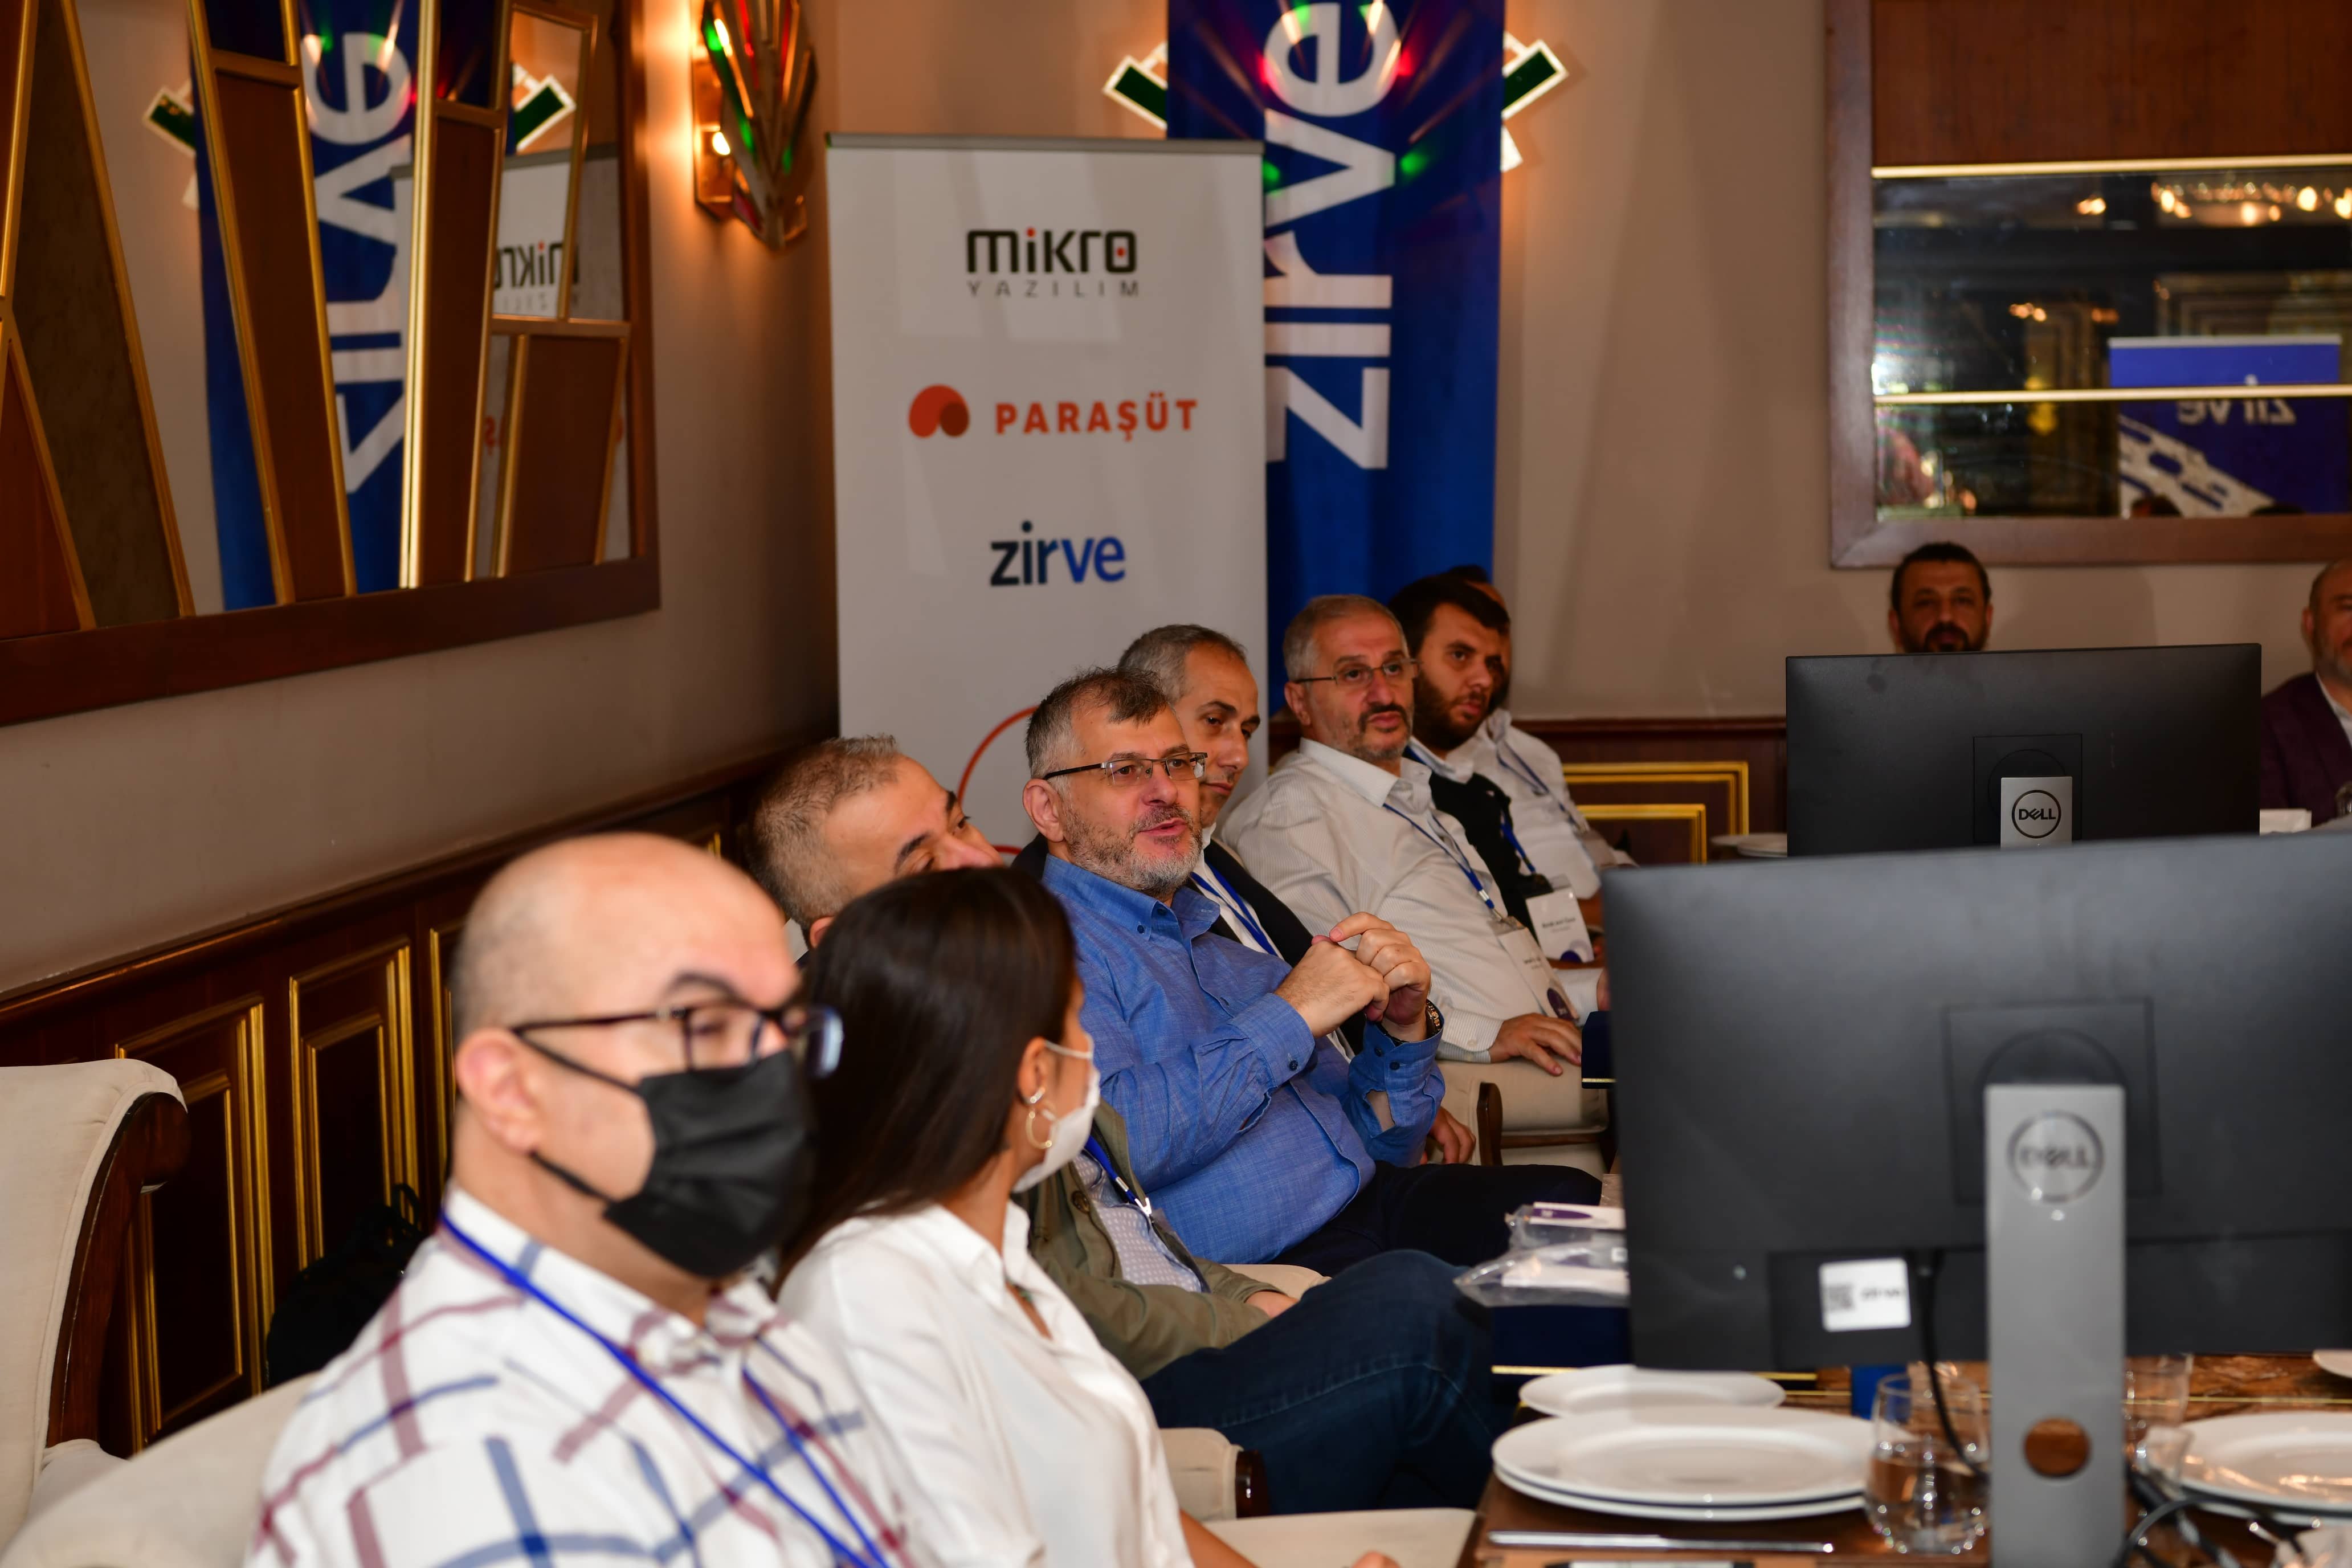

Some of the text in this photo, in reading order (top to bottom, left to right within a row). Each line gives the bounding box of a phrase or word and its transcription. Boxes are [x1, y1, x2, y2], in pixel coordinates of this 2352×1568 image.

[966, 227, 1137, 273] mikro
[1263, 2, 1401, 469] zirve
[967, 279, 1139, 297] YAZILIM
[995, 391, 1198, 442] PARAŞÜT
[990, 520, 1126, 586] zirve
[2019, 808, 2056, 820] DELL
